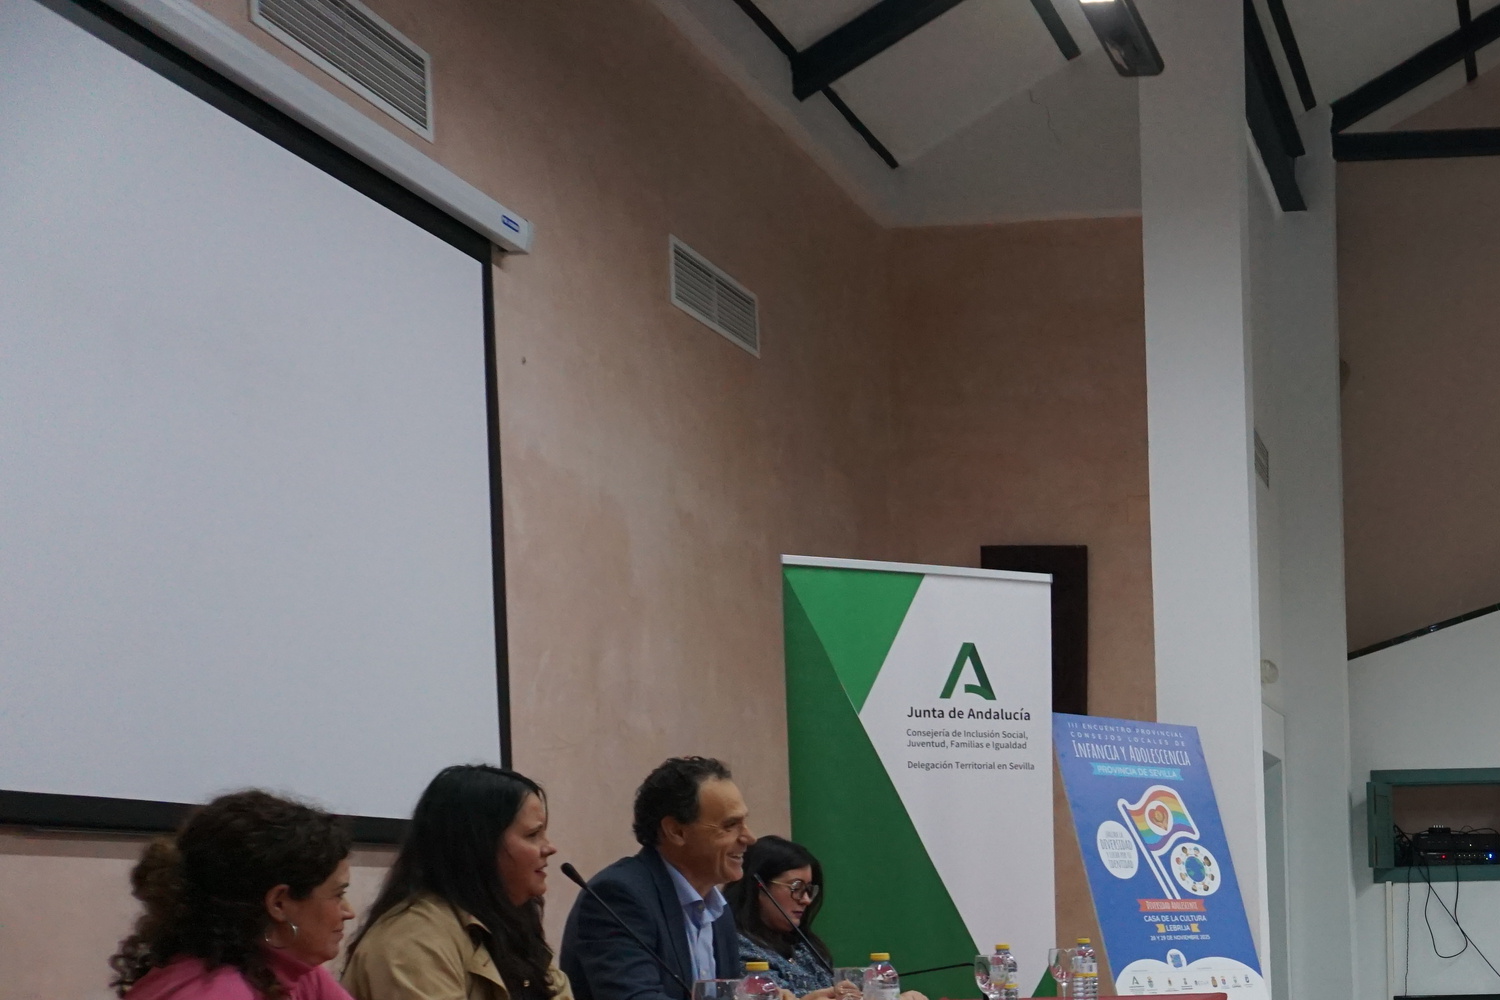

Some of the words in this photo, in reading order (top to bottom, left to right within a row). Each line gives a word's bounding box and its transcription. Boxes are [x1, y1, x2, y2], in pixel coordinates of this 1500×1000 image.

[907, 706, 945, 719] Junta
[948, 707, 964, 720] de
[967, 707, 1031, 721] Andalucía
[906, 728, 950, 739] Consejería
[951, 729, 962, 738] de
[963, 729, 1000, 739] Inclusión
[1001, 730, 1029, 740] Social,
[1082, 723, 1132, 734] ENCUENTRO
[1135, 728, 1183, 739] PROVINCIAL
[906, 739, 949, 750] Juventud,
[950, 740, 984, 749] Familias
[992, 741, 1027, 751] Igualdad
[1070, 731, 1122, 742] CONSEJOS
[1127, 736, 1169, 746] LOCALES
[1072, 740, 1120, 761] INFANCIA
[1120, 745, 1127, 761] Y
[1129, 745, 1191, 766] ADOLESCENCIA
[907, 760, 953, 771] Delegación
[954, 761, 996, 770] Territorial
[1009, 761, 1035, 771] Sevilla
[1096, 765, 1137, 775] PROVINCIA
[1137, 767, 1148, 776] DE
[1148, 768, 1178, 778] SEVILLA
[1143, 915, 1161, 923] CASA
[1179, 914, 1208, 922] CULTURA
